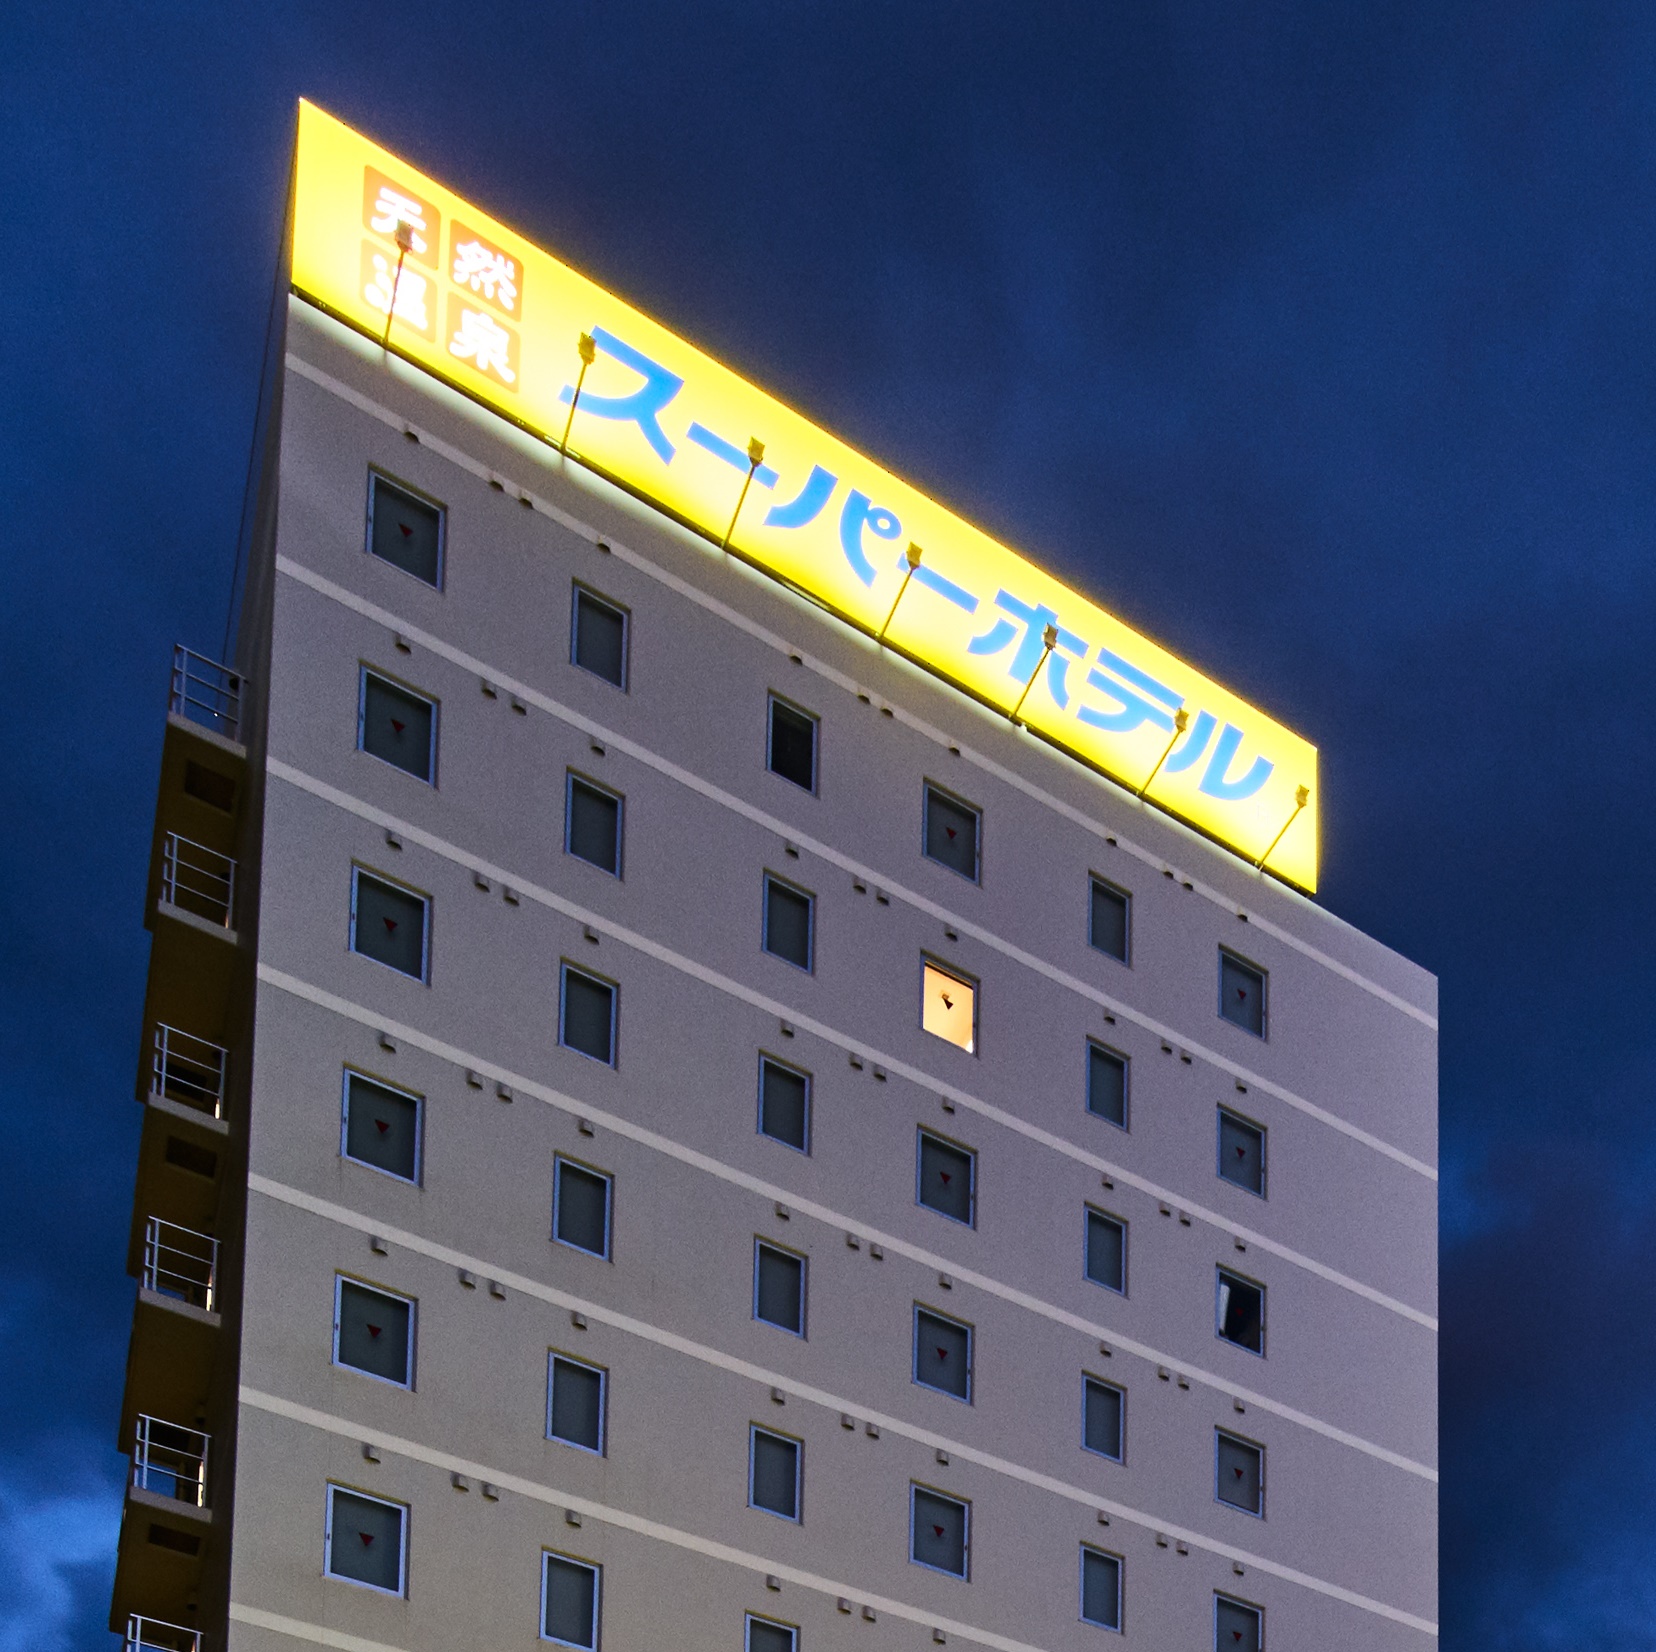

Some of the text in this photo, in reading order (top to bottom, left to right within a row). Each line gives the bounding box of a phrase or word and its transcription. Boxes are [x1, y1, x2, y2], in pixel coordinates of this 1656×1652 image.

[558, 325, 1274, 801] スーパーホテル
